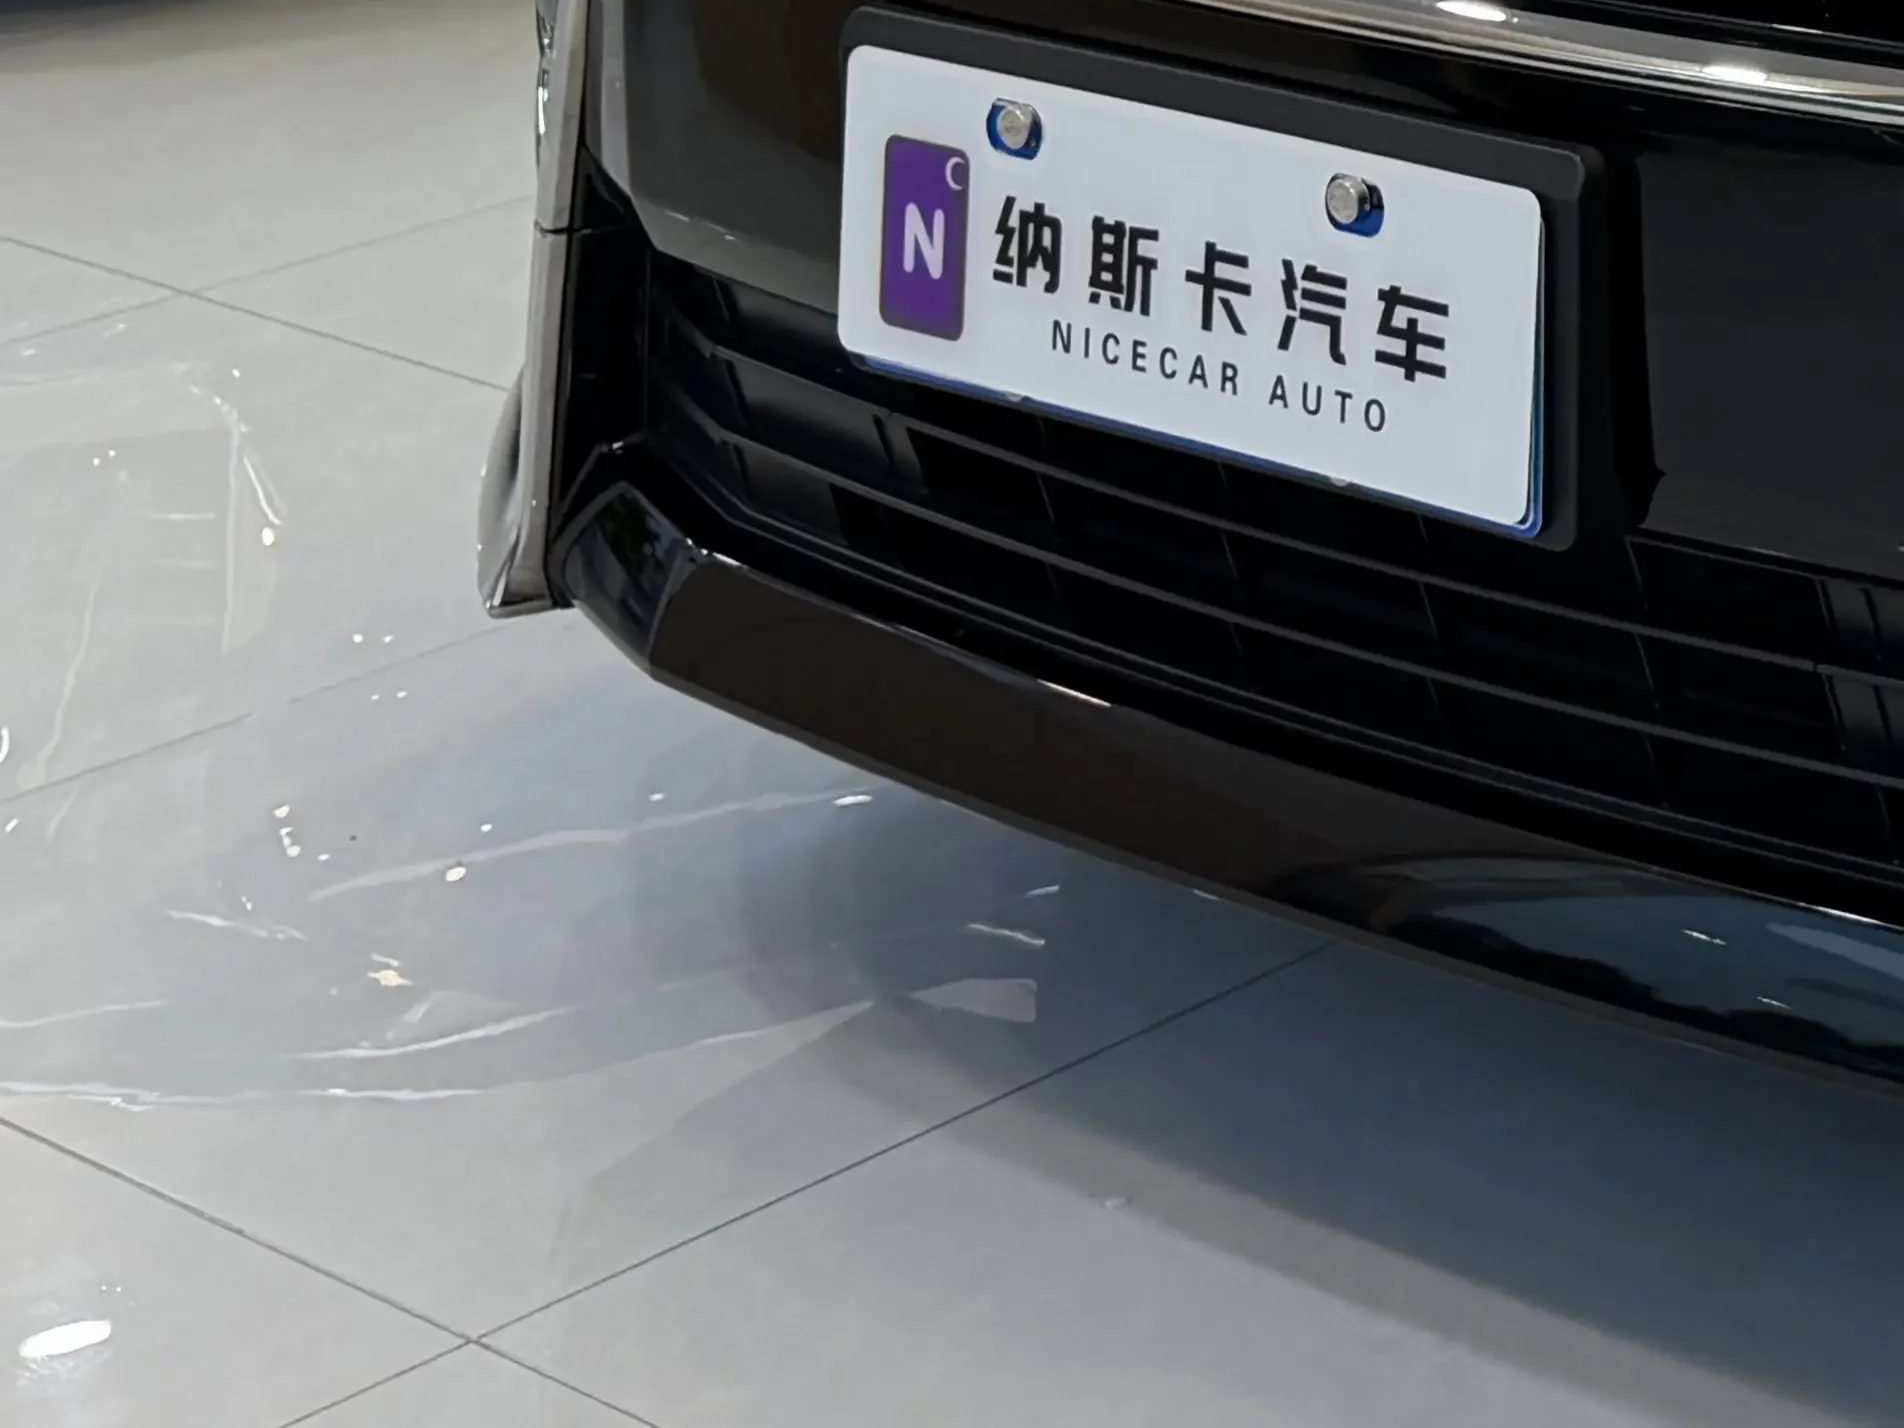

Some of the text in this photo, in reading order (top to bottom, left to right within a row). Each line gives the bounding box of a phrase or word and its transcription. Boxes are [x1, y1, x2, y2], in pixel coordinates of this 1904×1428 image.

[992, 194, 1450, 383] 纳斯卡汽车
[1051, 318, 1387, 433] NICECAR AUTO
